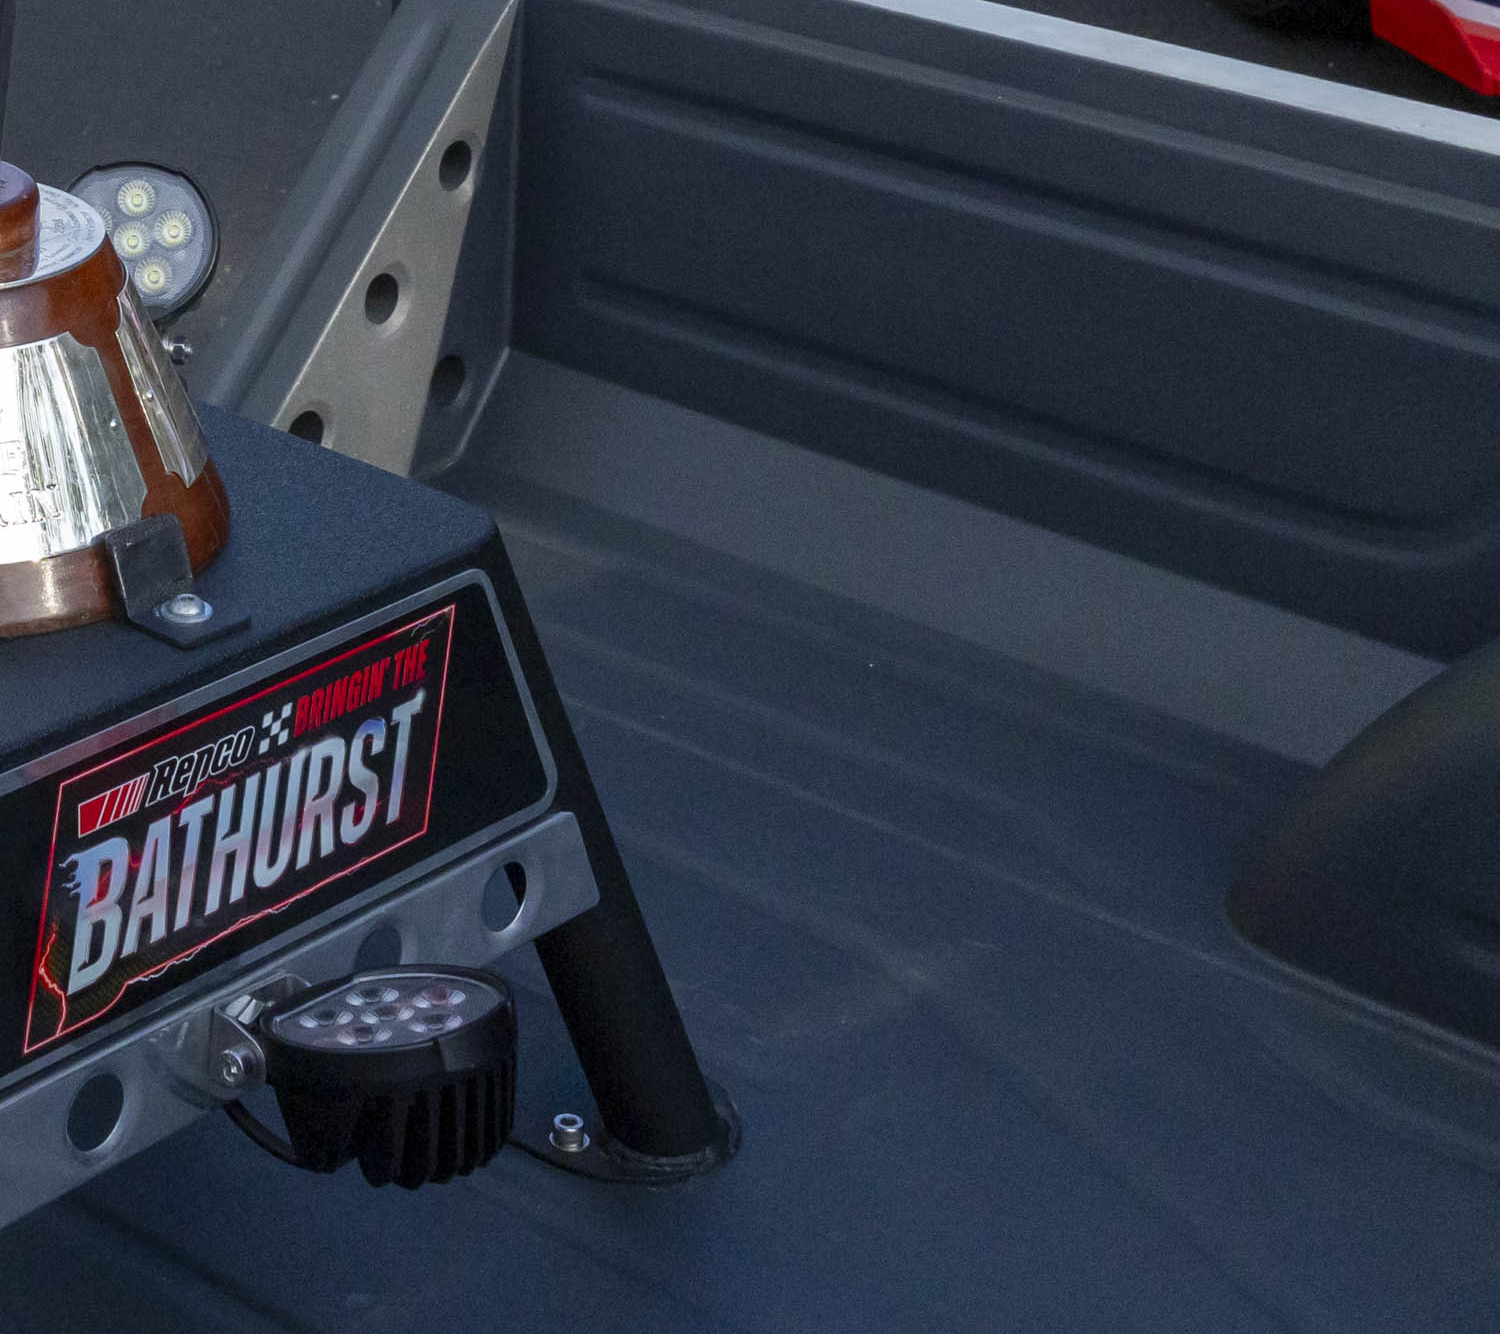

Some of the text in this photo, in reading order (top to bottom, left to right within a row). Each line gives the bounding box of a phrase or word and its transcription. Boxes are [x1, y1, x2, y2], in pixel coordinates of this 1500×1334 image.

[293, 657, 391, 738] BRINGIN'
[386, 638, 431, 692] THE
[60, 687, 428, 997] BATHURST
